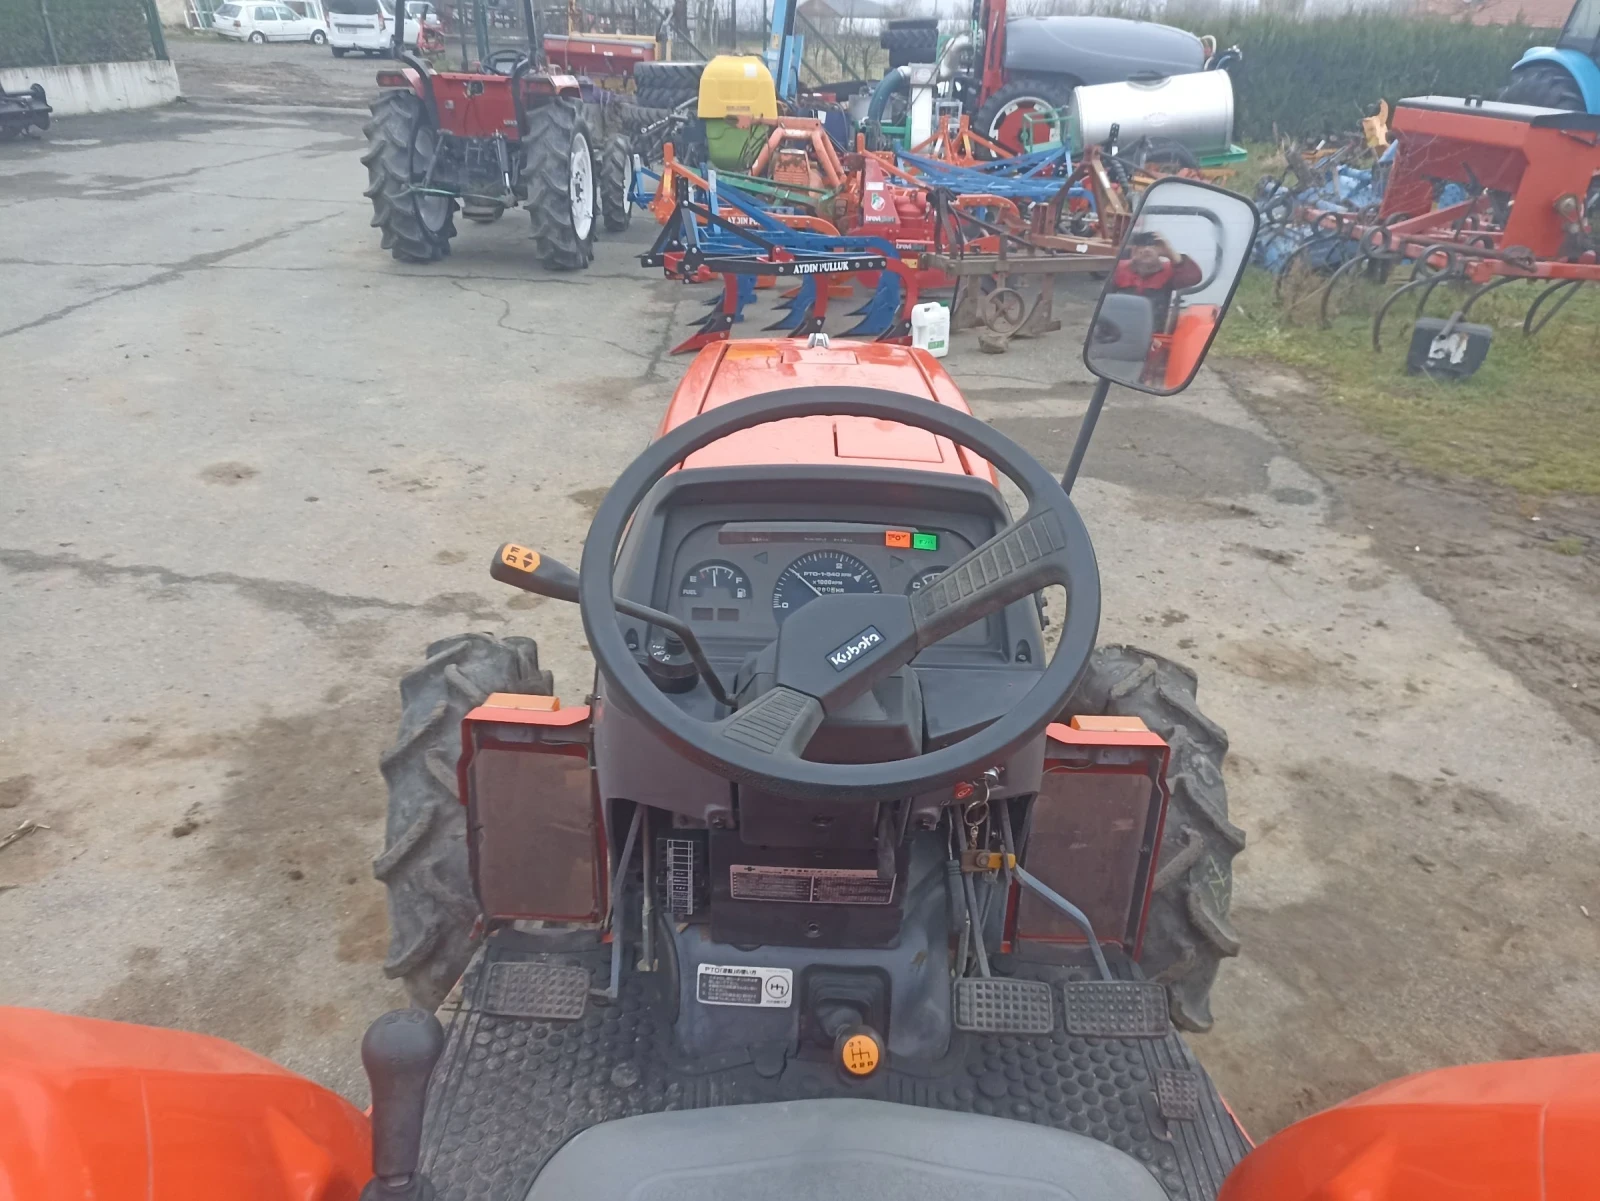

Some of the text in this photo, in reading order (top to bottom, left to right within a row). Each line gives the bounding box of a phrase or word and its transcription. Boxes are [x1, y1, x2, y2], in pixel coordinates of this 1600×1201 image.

[793, 264, 818, 274] AYDIN
[506, 554, 517, 563] R
[689, 575, 697, 583] E
[831, 633, 880, 665] Kubota
